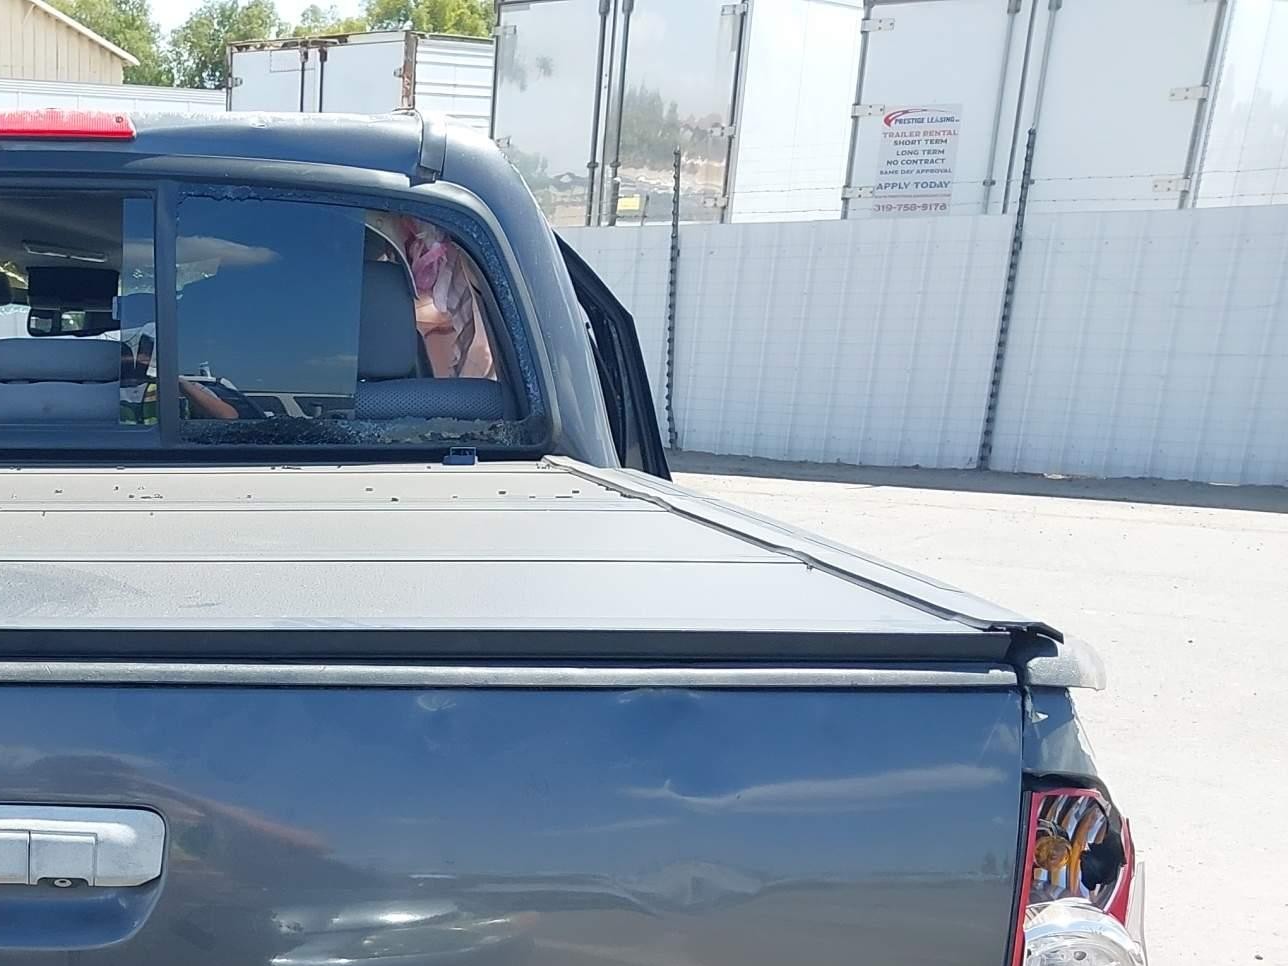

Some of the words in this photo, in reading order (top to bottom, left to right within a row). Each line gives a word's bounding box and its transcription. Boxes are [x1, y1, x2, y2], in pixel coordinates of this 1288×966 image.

[894, 117, 925, 125] PRESTIGE
[926, 116, 955, 124] LEASING
[882, 130, 921, 138] TRAILER
[922, 129, 958, 137] RENTAL
[922, 148, 945, 156] TERM
[875, 181, 911, 191] APPLY
[913, 180, 951, 189] TODAY
